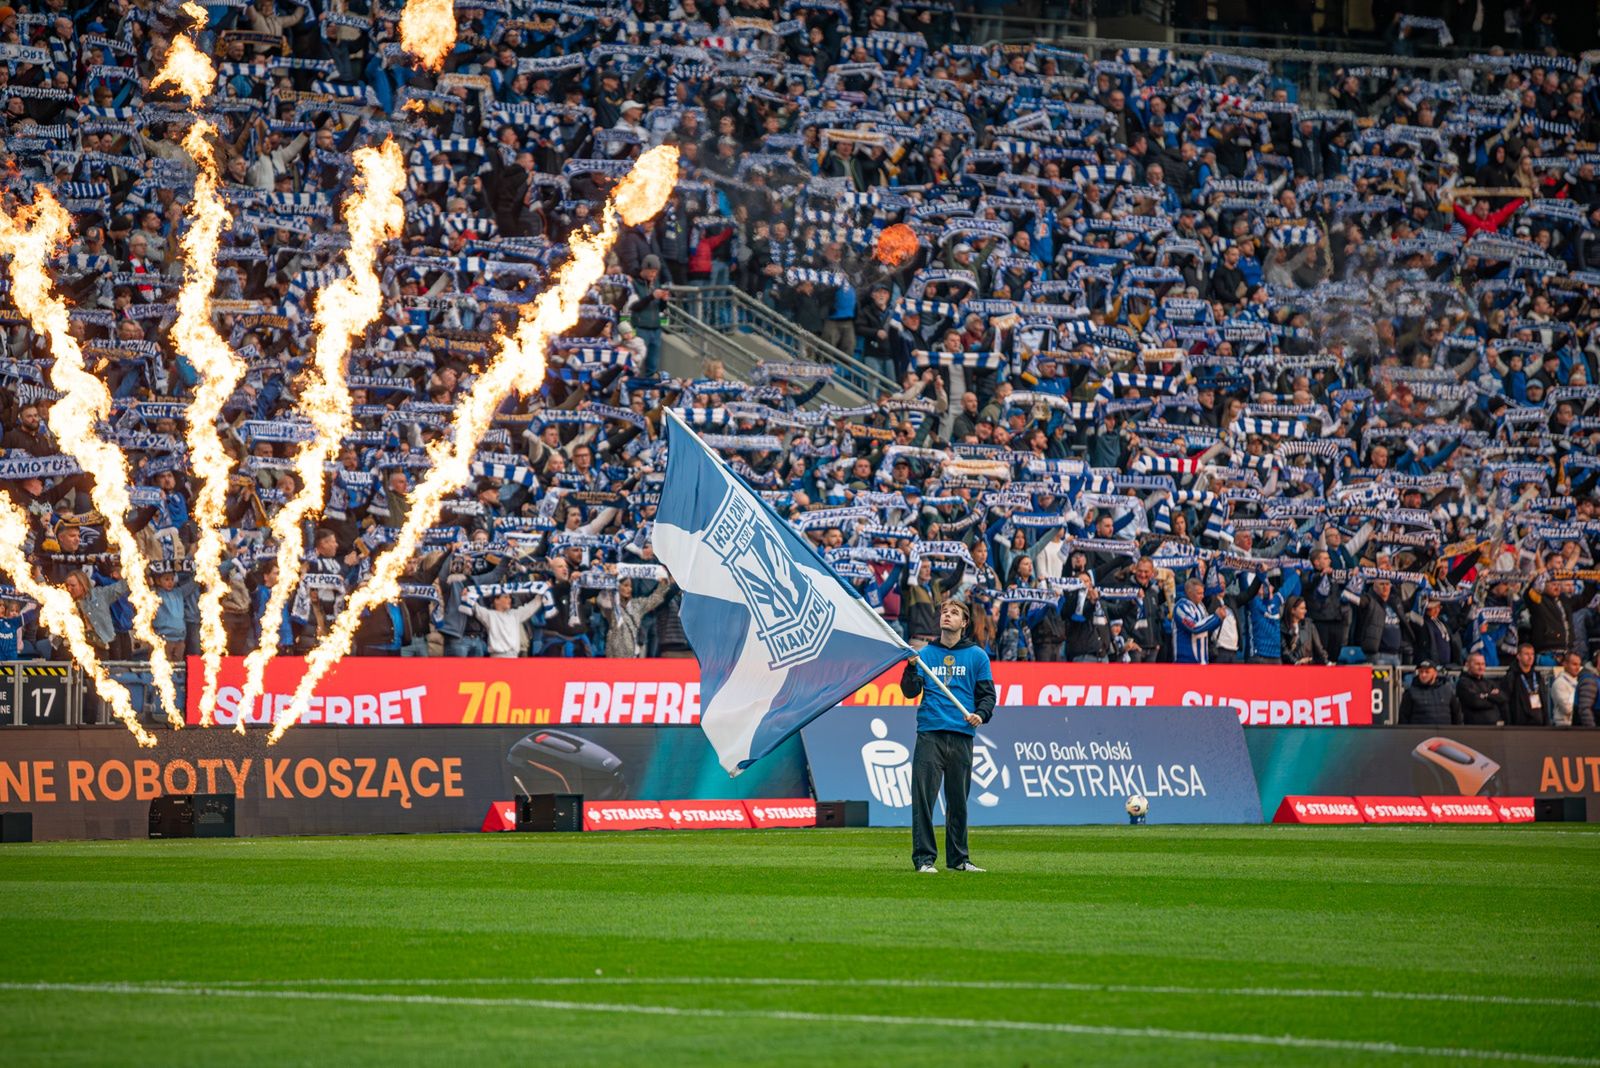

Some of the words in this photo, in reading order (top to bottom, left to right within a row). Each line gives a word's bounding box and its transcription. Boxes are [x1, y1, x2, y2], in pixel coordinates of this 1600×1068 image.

[31, 687, 56, 717] 17
[458, 682, 511, 724] 70
[1014, 742, 1046, 761] PKO
[1050, 742, 1088, 761] Bank
[1089, 741, 1132, 761] Polski
[69, 759, 252, 801] ROBOTY
[266, 757, 464, 808] KOSZĄCE
[1018, 764, 1207, 798] EKSTRAKLASA
[602, 807, 664, 822] STRAUSS
[683, 808, 745, 823] STRAUSS
[1307, 802, 1358, 816] STRAUSS
[1375, 804, 1428, 818] STRAUSS
[1442, 803, 1493, 817] STRAUSS
